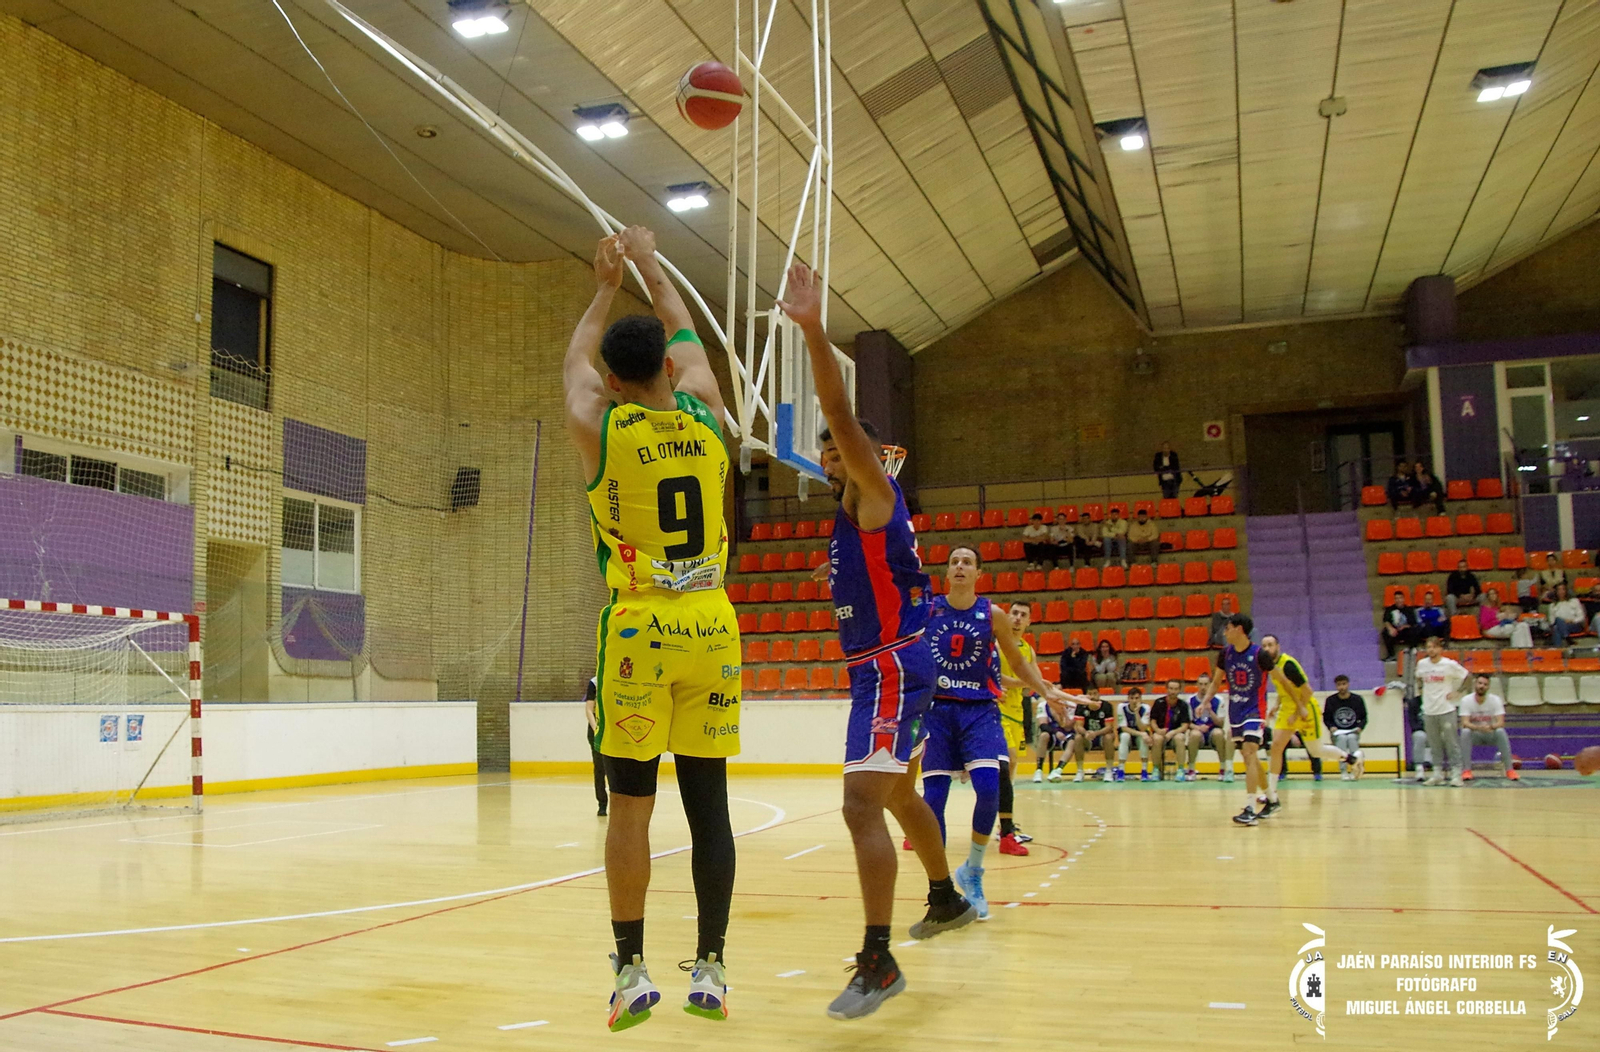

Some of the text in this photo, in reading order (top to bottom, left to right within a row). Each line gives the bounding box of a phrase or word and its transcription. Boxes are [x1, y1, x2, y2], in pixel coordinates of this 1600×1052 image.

[1461, 401, 1475, 417] A
[637, 439, 708, 465] EL OTMANI
[608, 478, 620, 524] RUSTER
[657, 475, 705, 561] 9
[646, 613, 730, 639] Andalucía
[953, 621, 980, 637] ZUBIA
[950, 634, 965, 657] 9
[938, 675, 981, 690] SUPER
